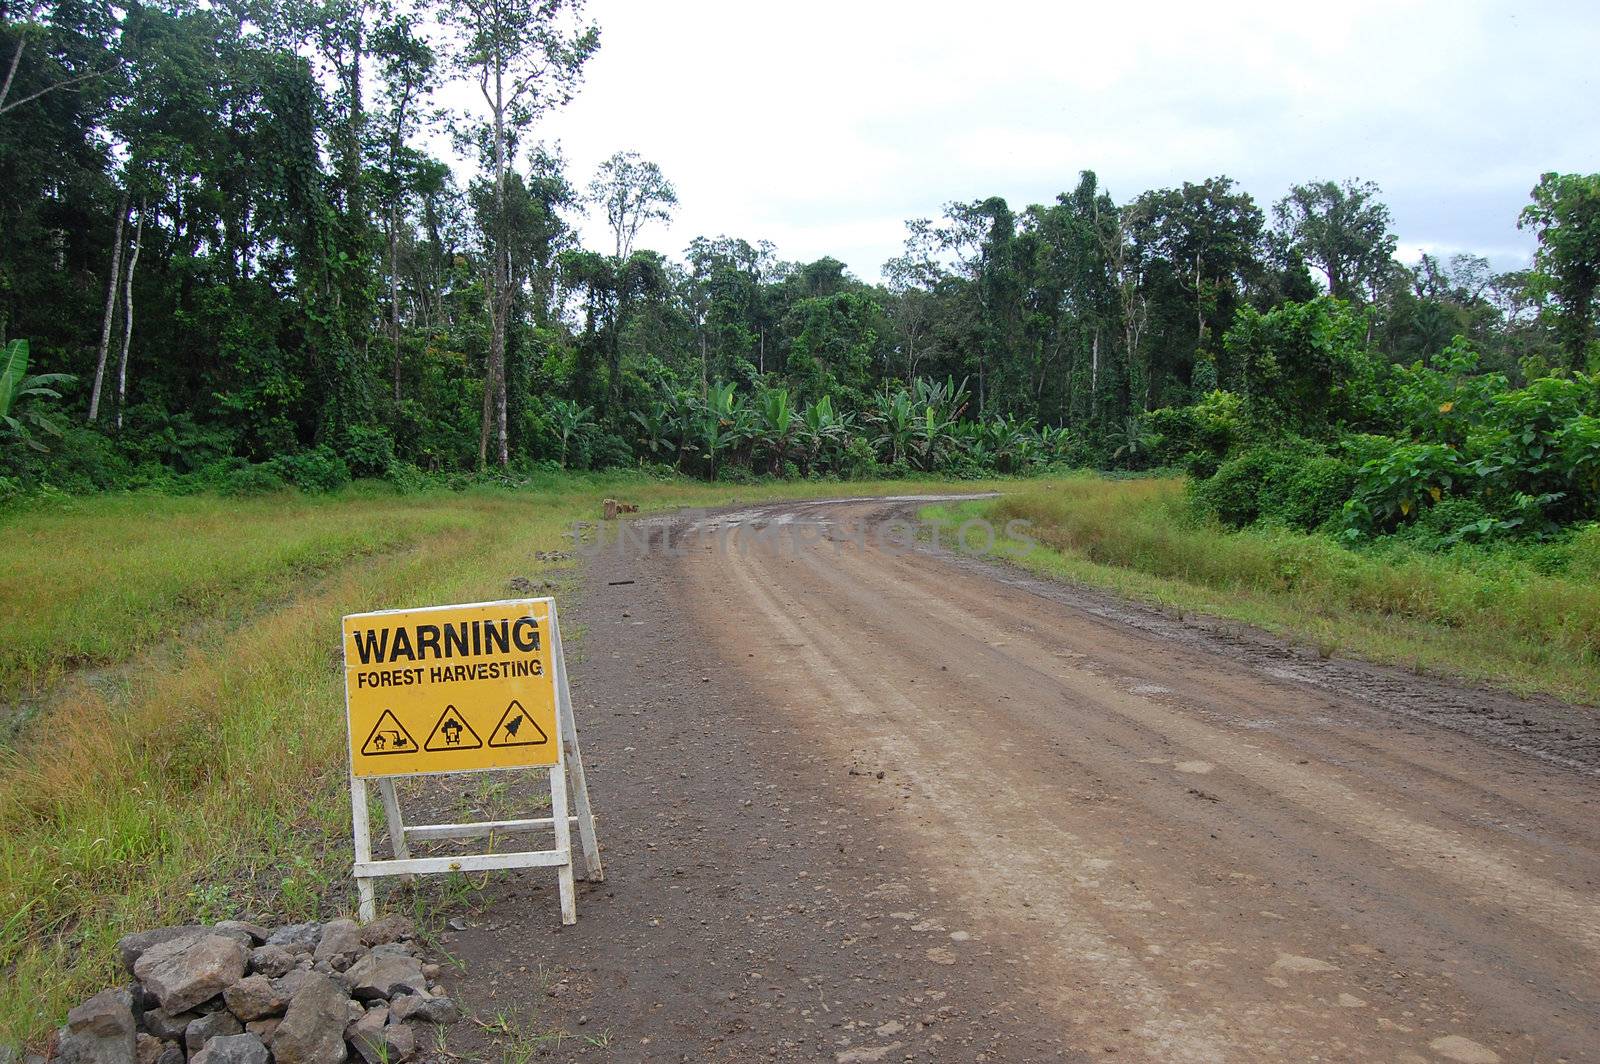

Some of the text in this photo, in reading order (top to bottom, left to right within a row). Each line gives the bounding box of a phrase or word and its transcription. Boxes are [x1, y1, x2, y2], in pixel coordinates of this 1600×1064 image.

[353, 616, 540, 664] WARNING
[358, 659, 543, 688] FOREST HARVESTING
